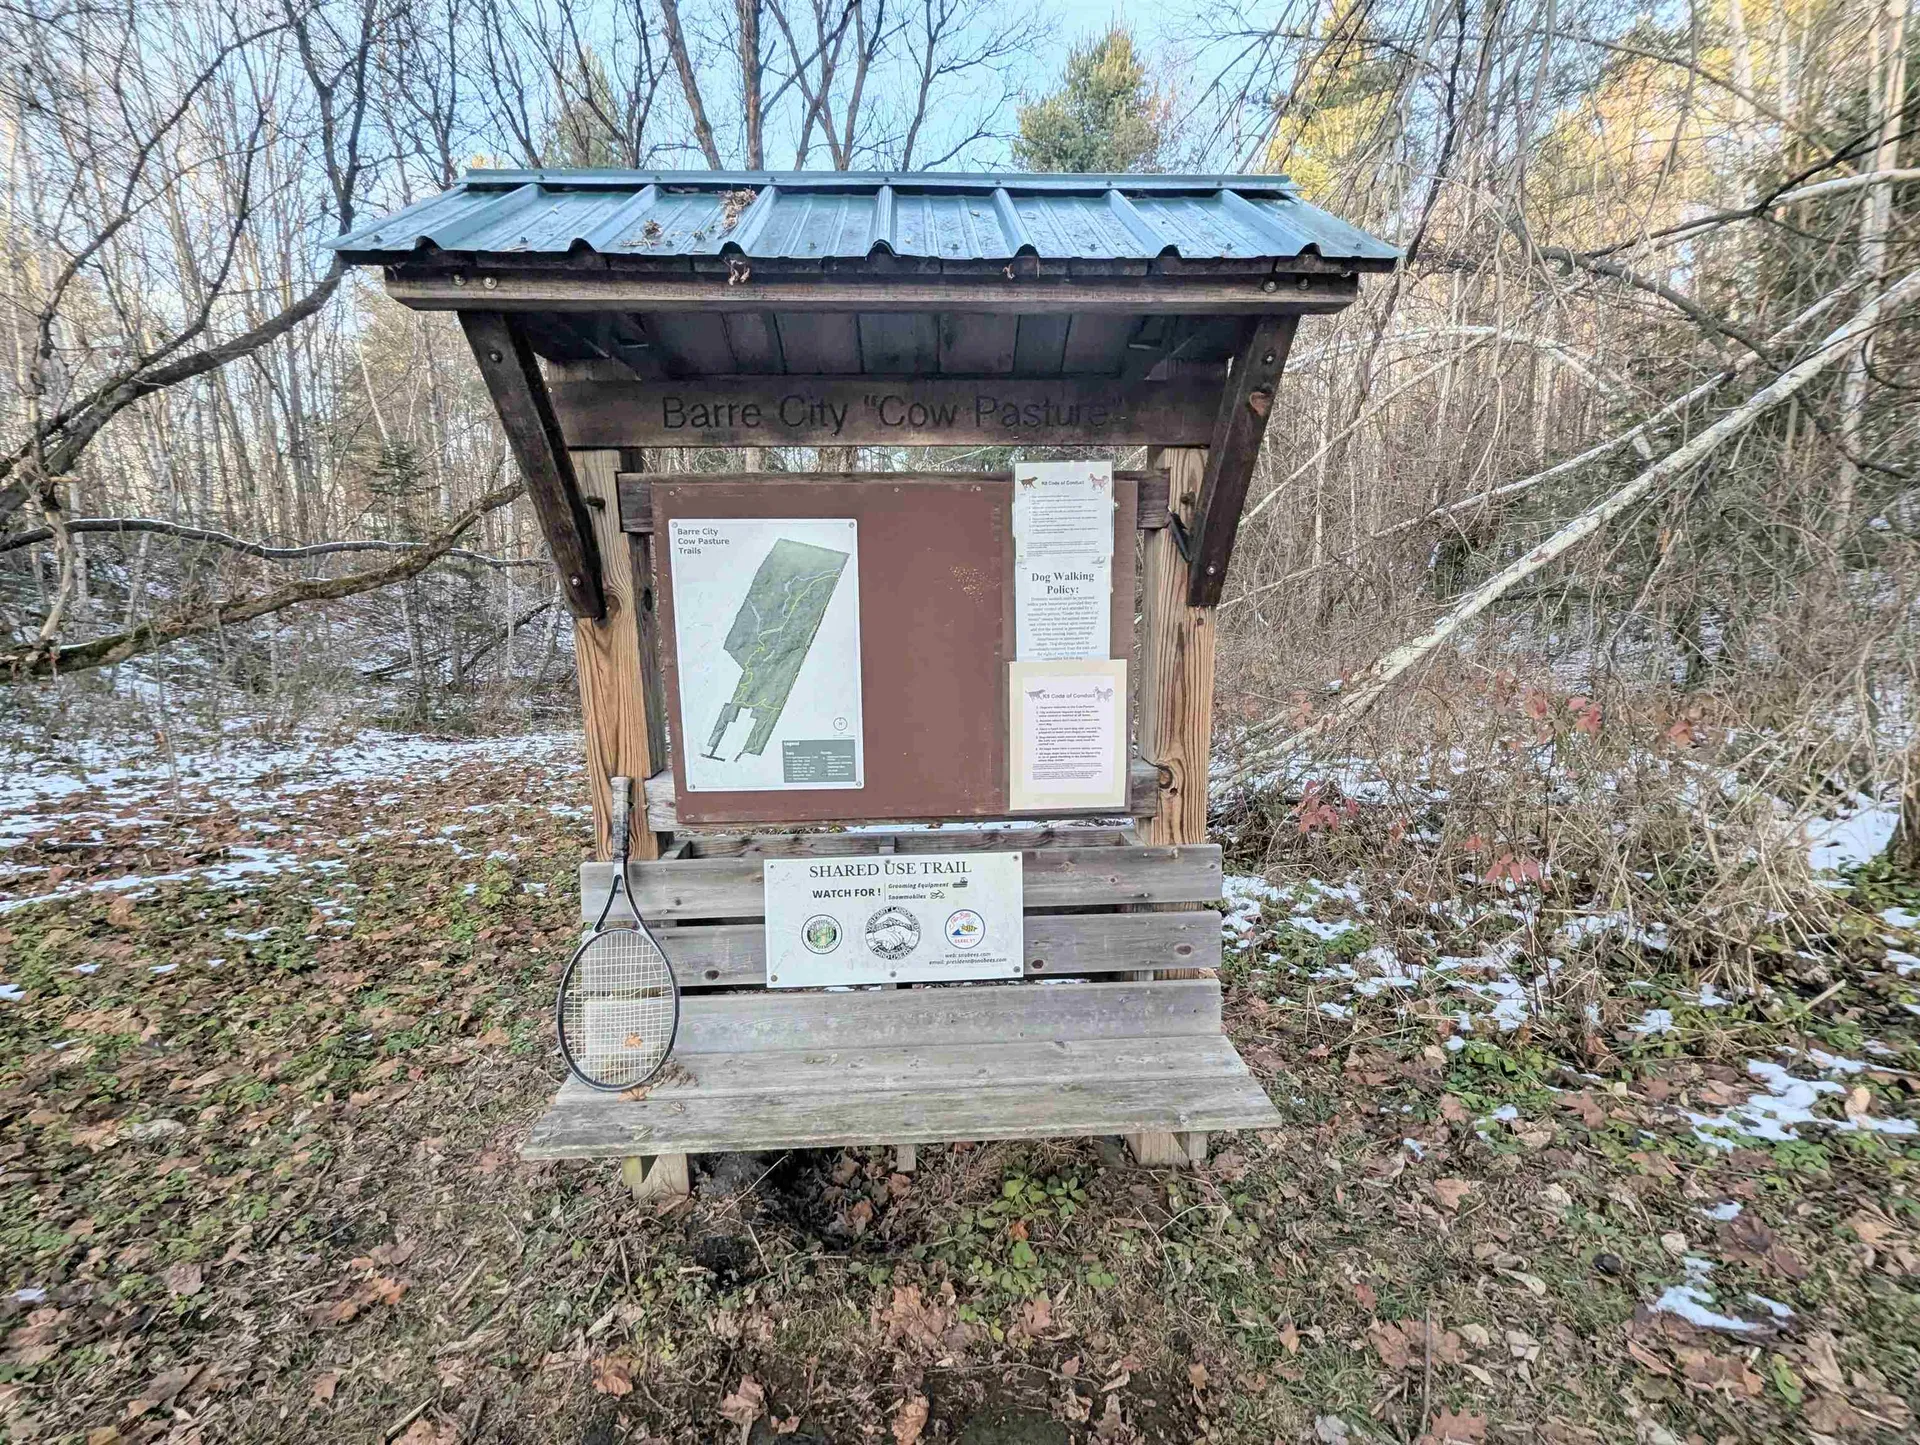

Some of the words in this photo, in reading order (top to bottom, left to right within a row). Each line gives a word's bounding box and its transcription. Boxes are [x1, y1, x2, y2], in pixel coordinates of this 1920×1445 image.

[662, 396, 762, 429] Barre
[779, 395, 849, 436] City
[702, 527, 719, 537] City
[677, 537, 696, 545] Cow
[698, 537, 730, 545] Pasture
[678, 547, 702, 555] Trails
[1031, 572, 1051, 584] Dog
[1053, 571, 1095, 582] Walking
[1047, 585, 1079, 596] Policy:
[809, 863, 880, 878] SHARED
[884, 862, 916, 876] USE
[920, 861, 972, 874] TRAIL
[812, 889, 851, 899] WATCH
[854, 888, 875, 898] FOR
